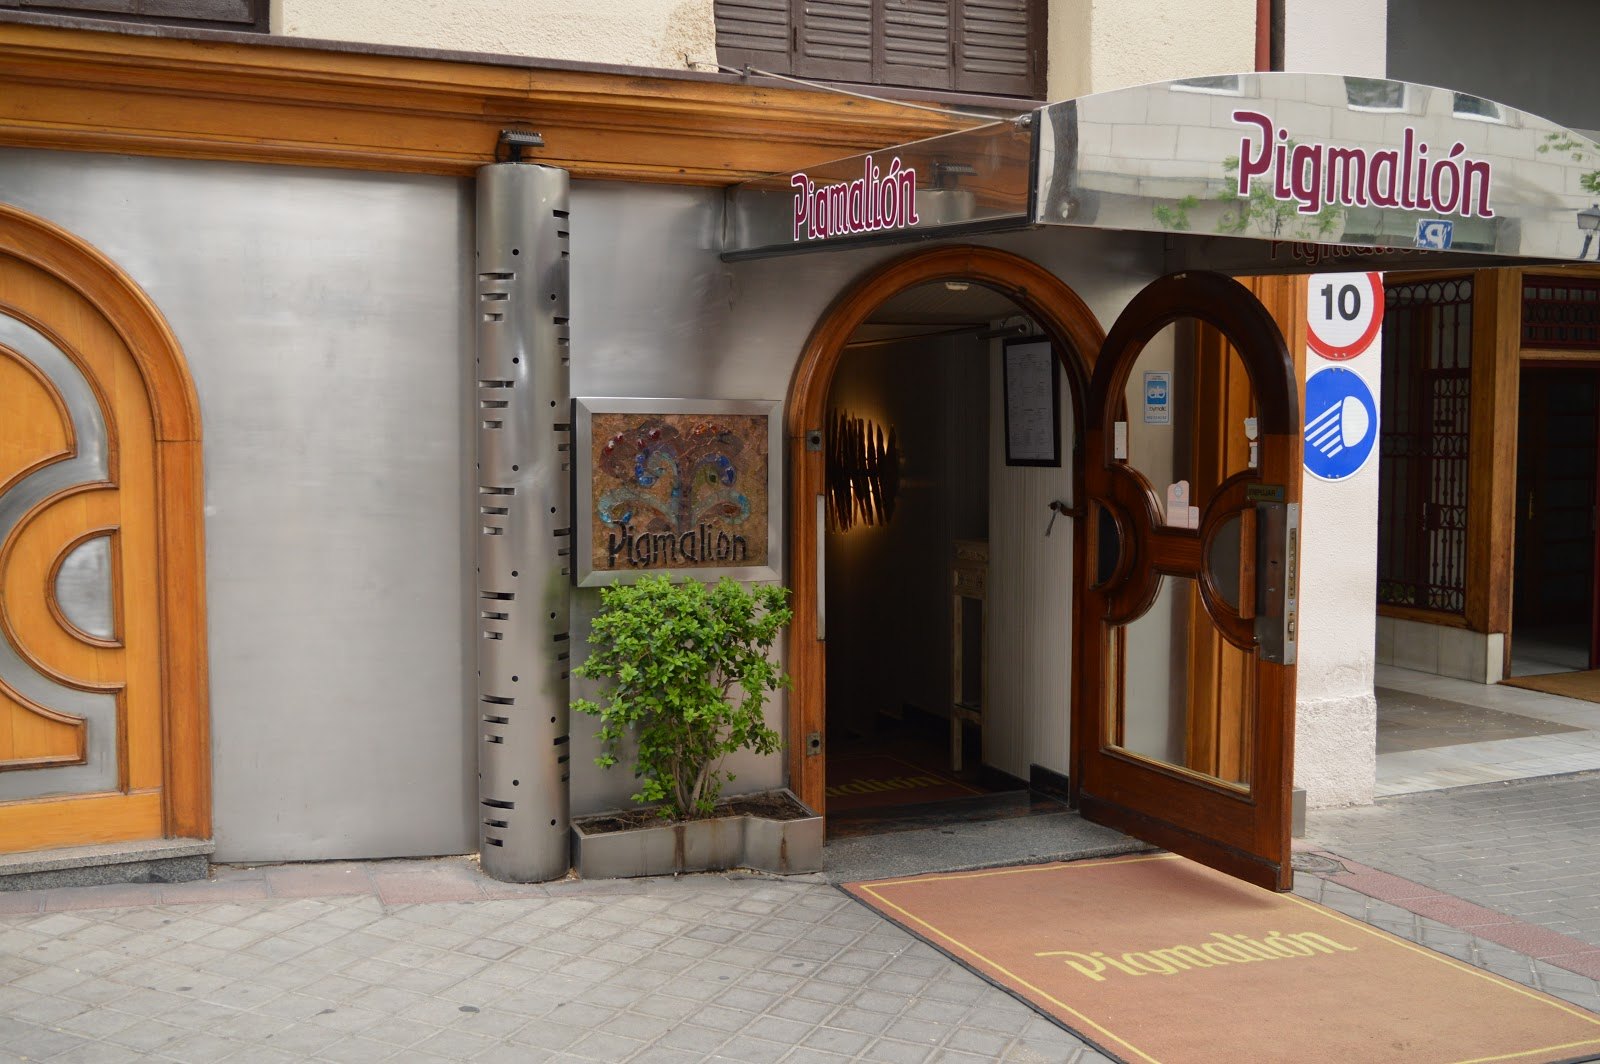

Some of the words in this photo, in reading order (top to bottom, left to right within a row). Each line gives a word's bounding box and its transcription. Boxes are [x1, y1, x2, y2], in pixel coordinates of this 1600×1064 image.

[791, 155, 919, 241] Pigmalión
[1232, 110, 1495, 219] Pigmalión
[1321, 283, 1361, 321] 10
[1034, 930, 1358, 982] Pigmalión
